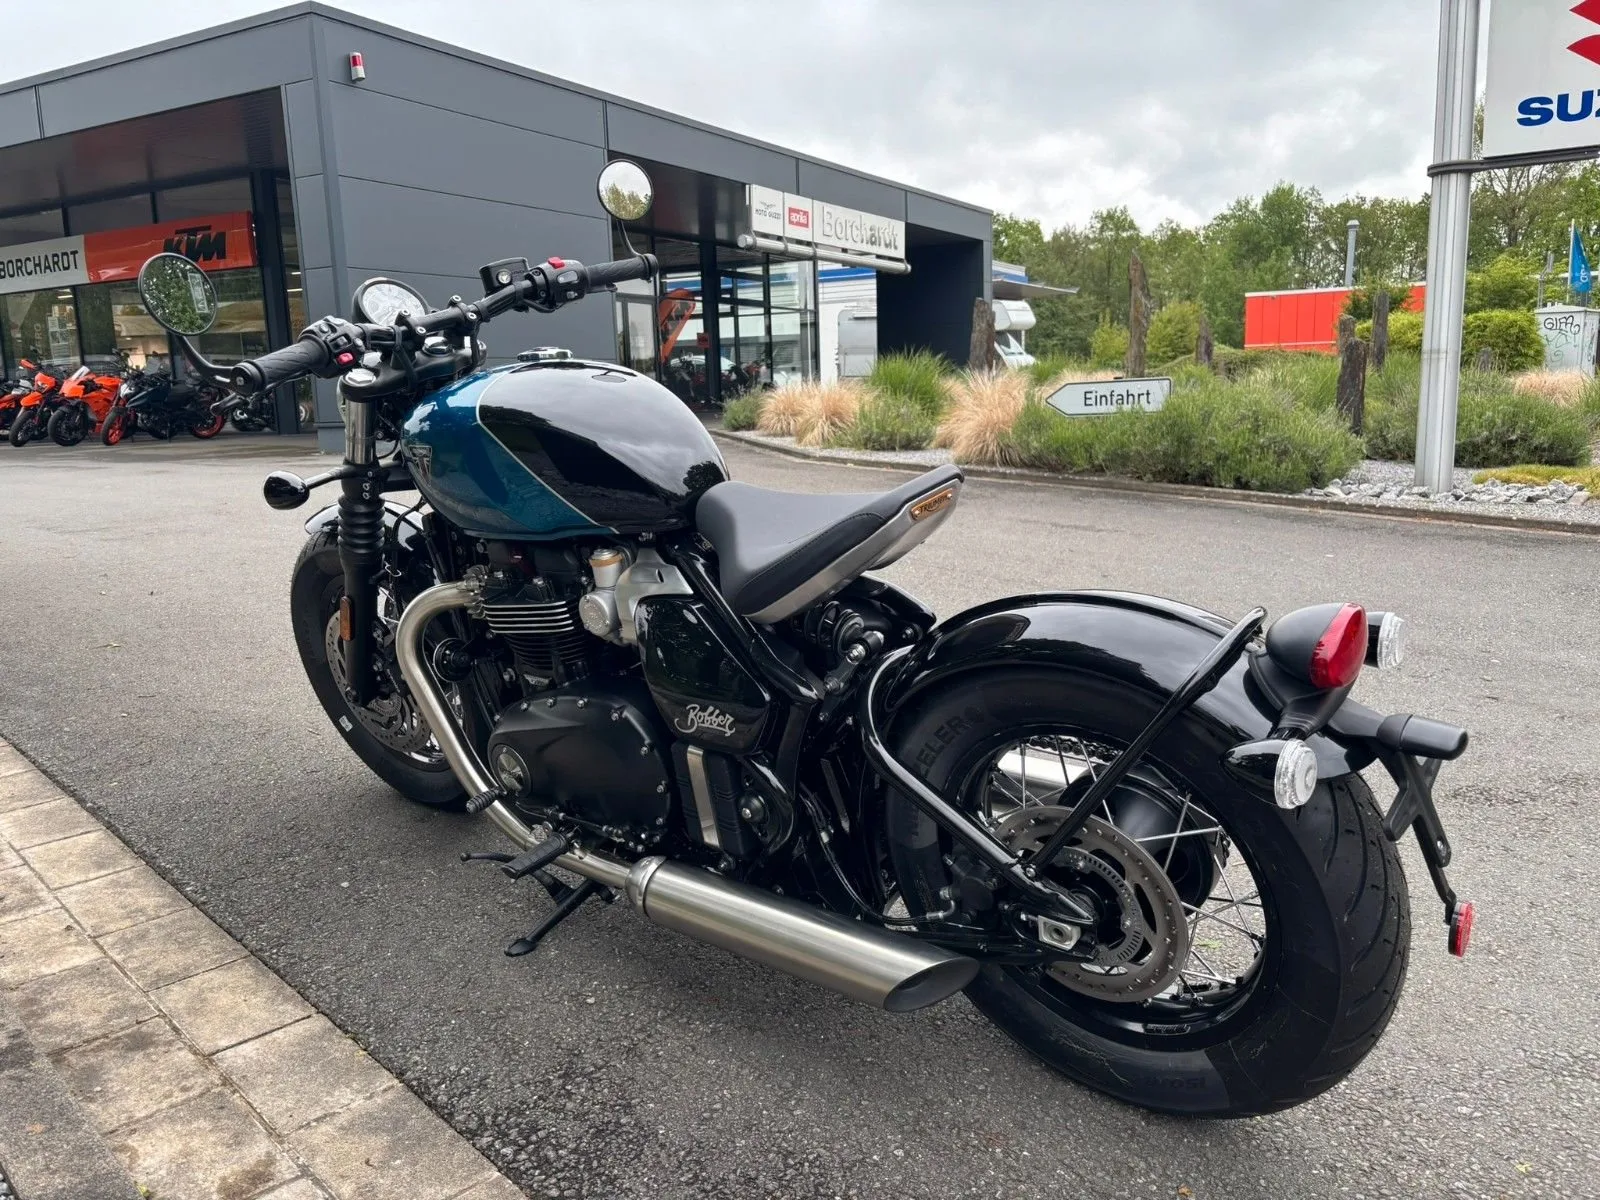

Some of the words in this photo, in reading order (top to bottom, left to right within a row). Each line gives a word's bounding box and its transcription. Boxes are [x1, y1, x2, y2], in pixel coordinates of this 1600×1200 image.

[1516, 88, 1600, 127] SU
[163, 225, 227, 261] KTM
[822, 205, 899, 250] Borchardt
[0, 250, 79, 280] BORCHARDT
[1083, 389, 1151, 407] Einfahrt
[674, 703, 736, 737] Bobber
